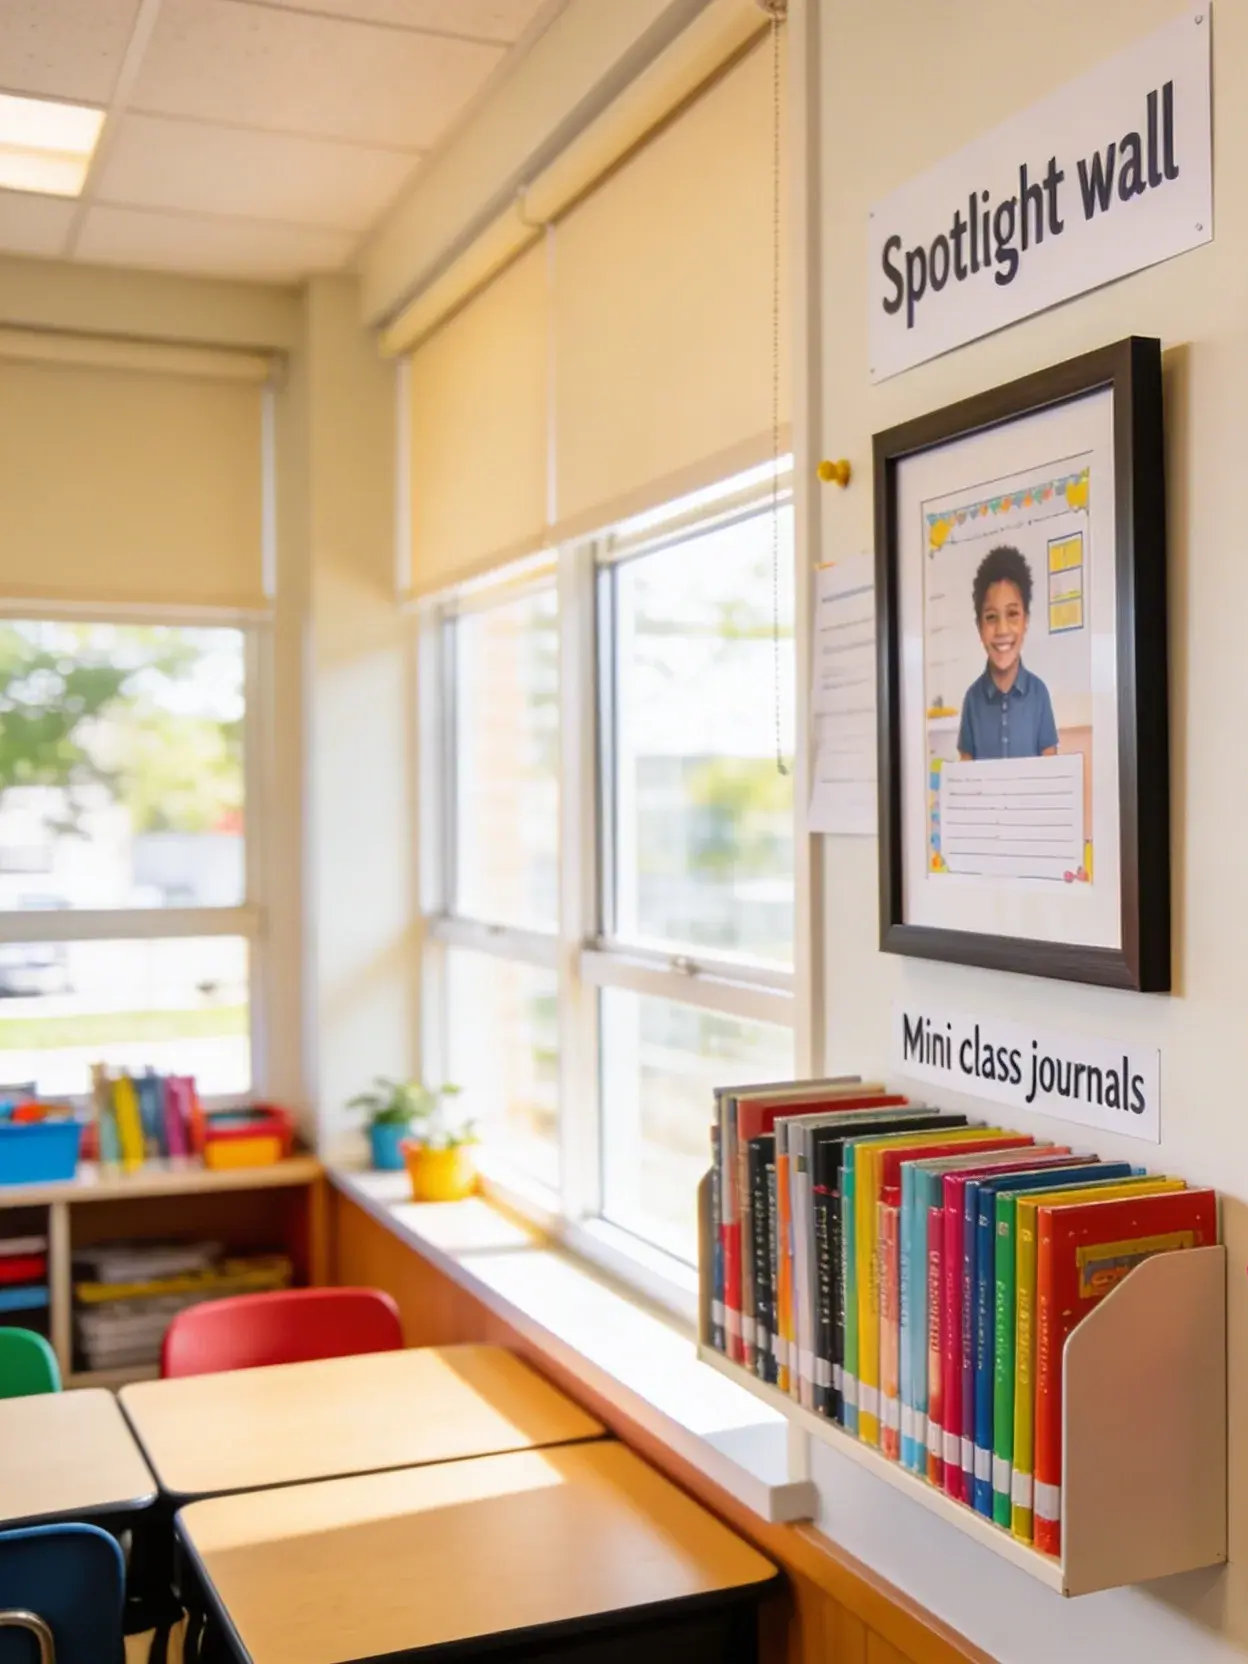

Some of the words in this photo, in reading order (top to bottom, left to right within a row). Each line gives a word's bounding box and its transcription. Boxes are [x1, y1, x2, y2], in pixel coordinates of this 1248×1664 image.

[881, 155, 1065, 329] Spotlight
[1076, 79, 1180, 221] wall
[903, 1013, 952, 1070] Mini
[959, 1023, 1022, 1085] class
[1025, 1039, 1146, 1115] journals
